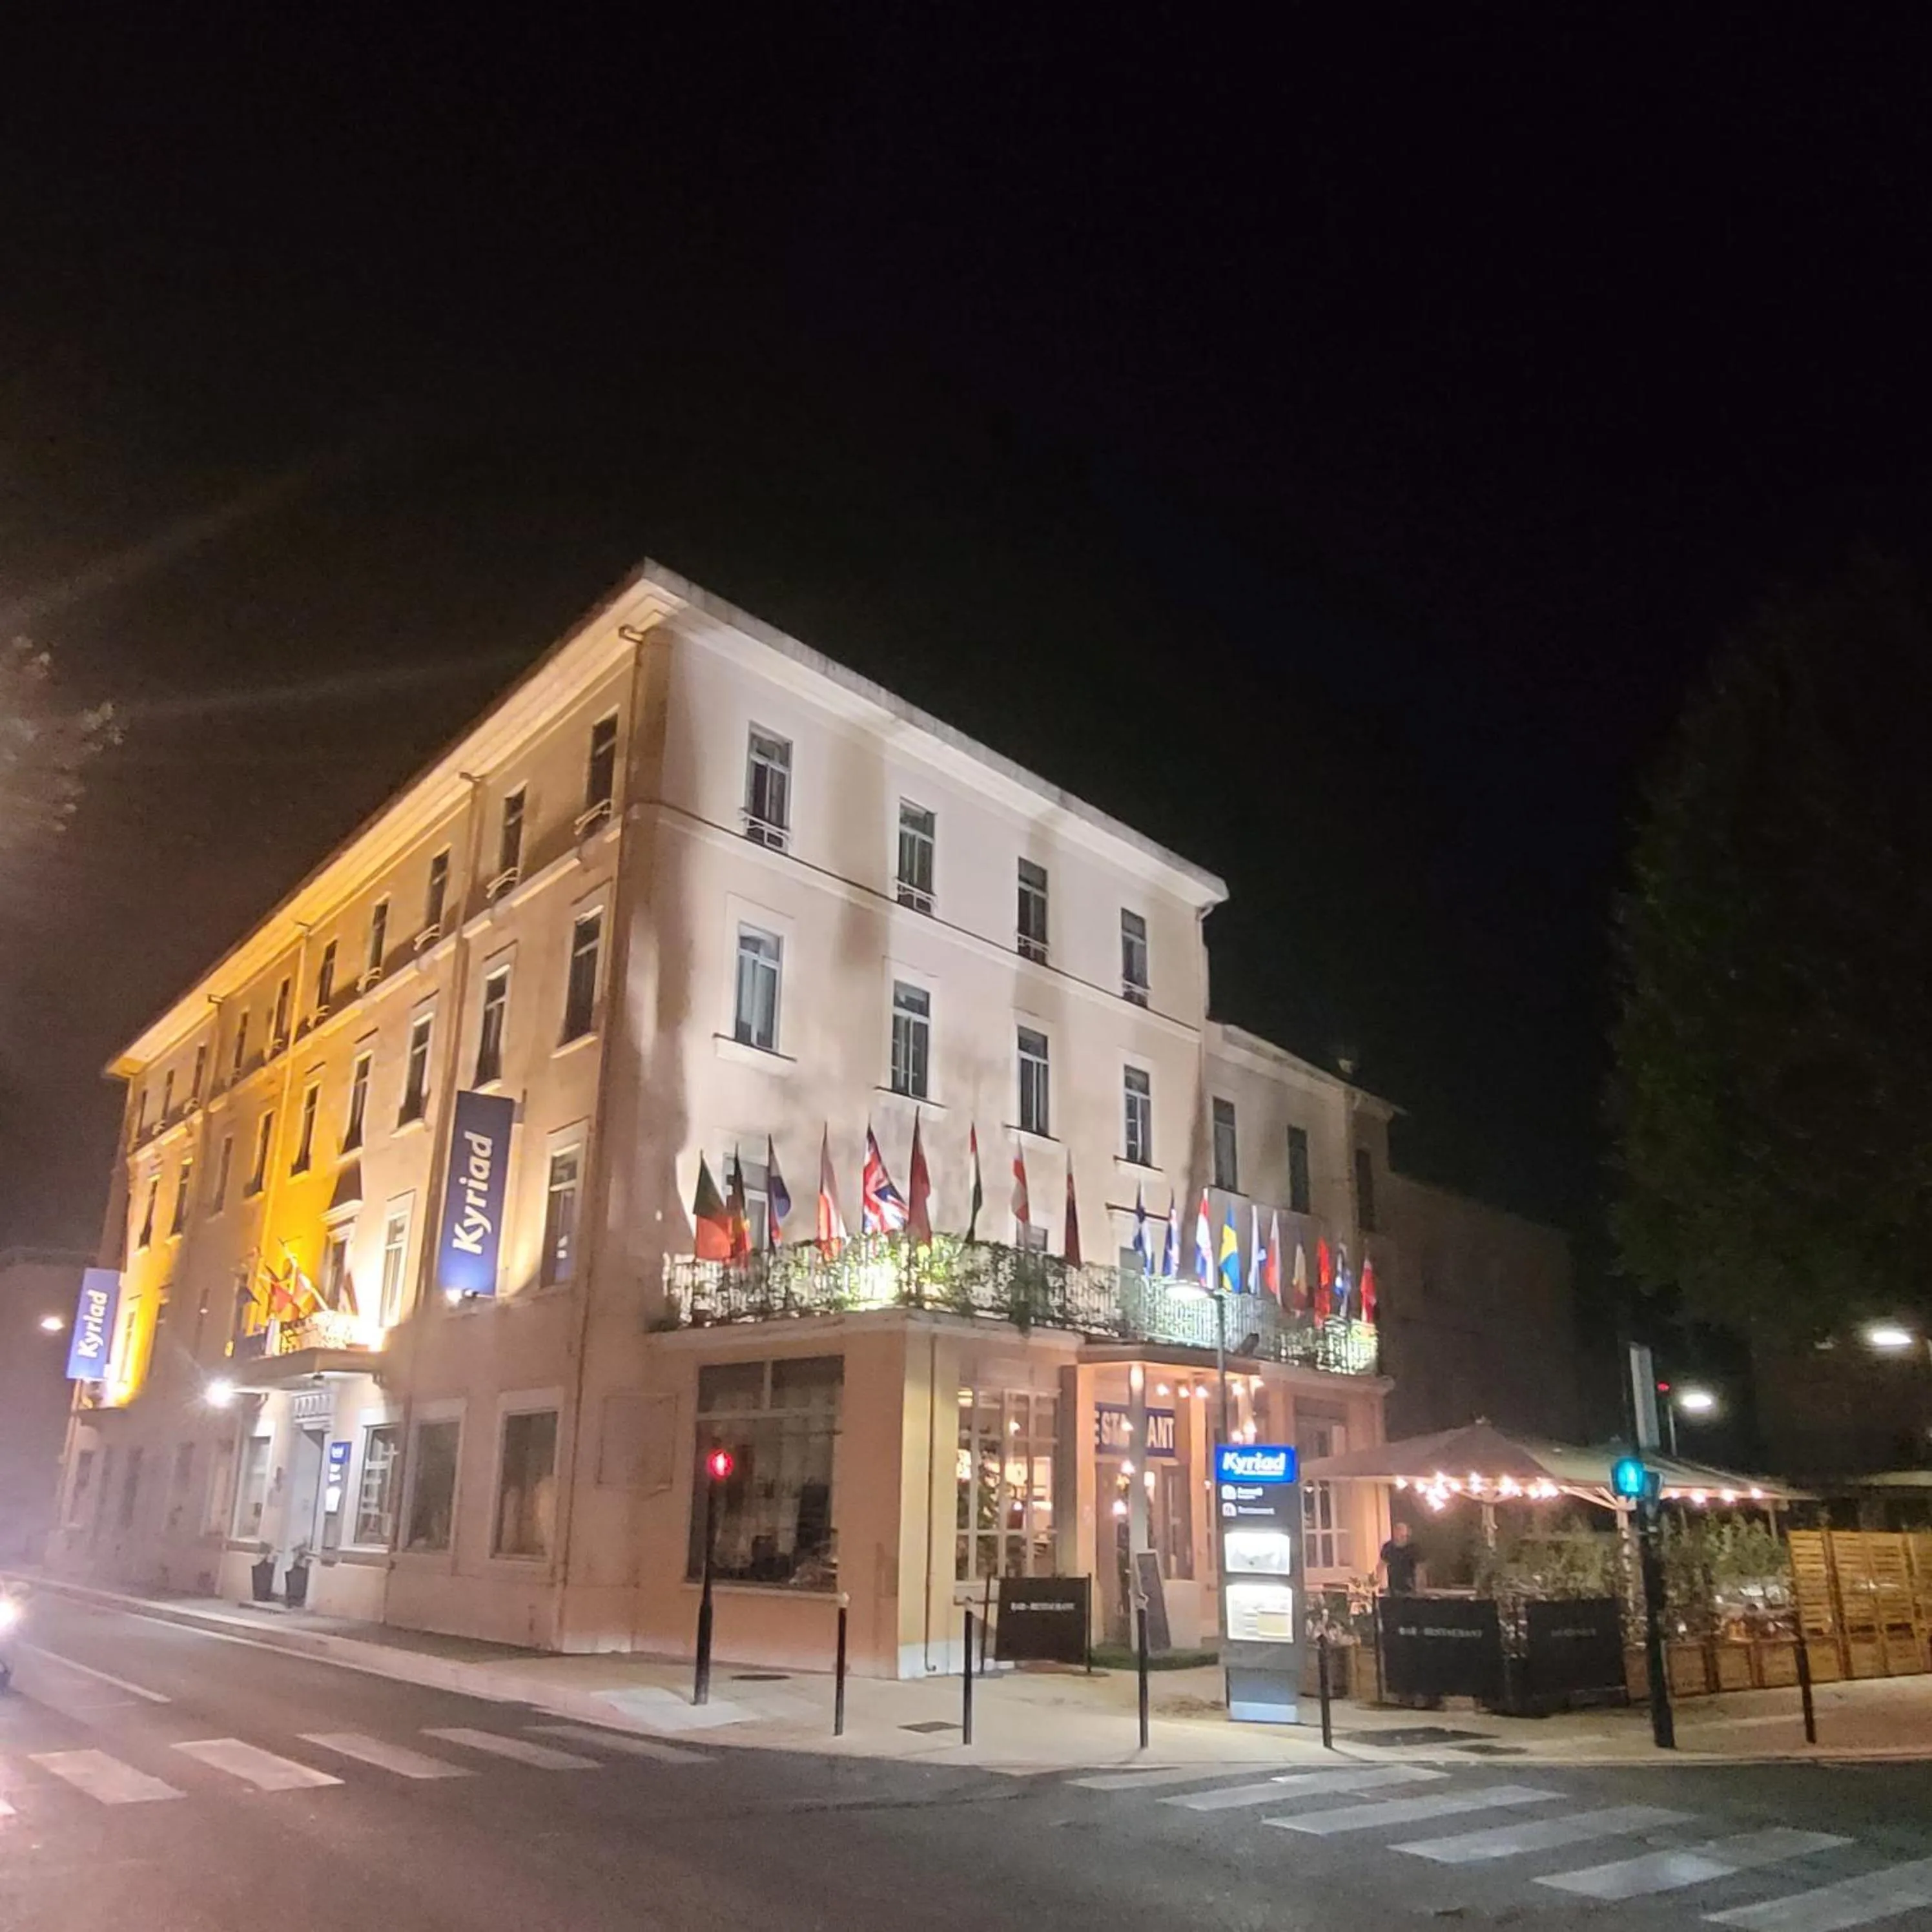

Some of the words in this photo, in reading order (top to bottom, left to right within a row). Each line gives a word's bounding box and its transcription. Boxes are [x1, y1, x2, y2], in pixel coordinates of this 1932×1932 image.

[452, 1131, 493, 1255] Kyriad
[77, 1289, 108, 1359] Kyriad
[1222, 1451, 1286, 1476] Kyriad
